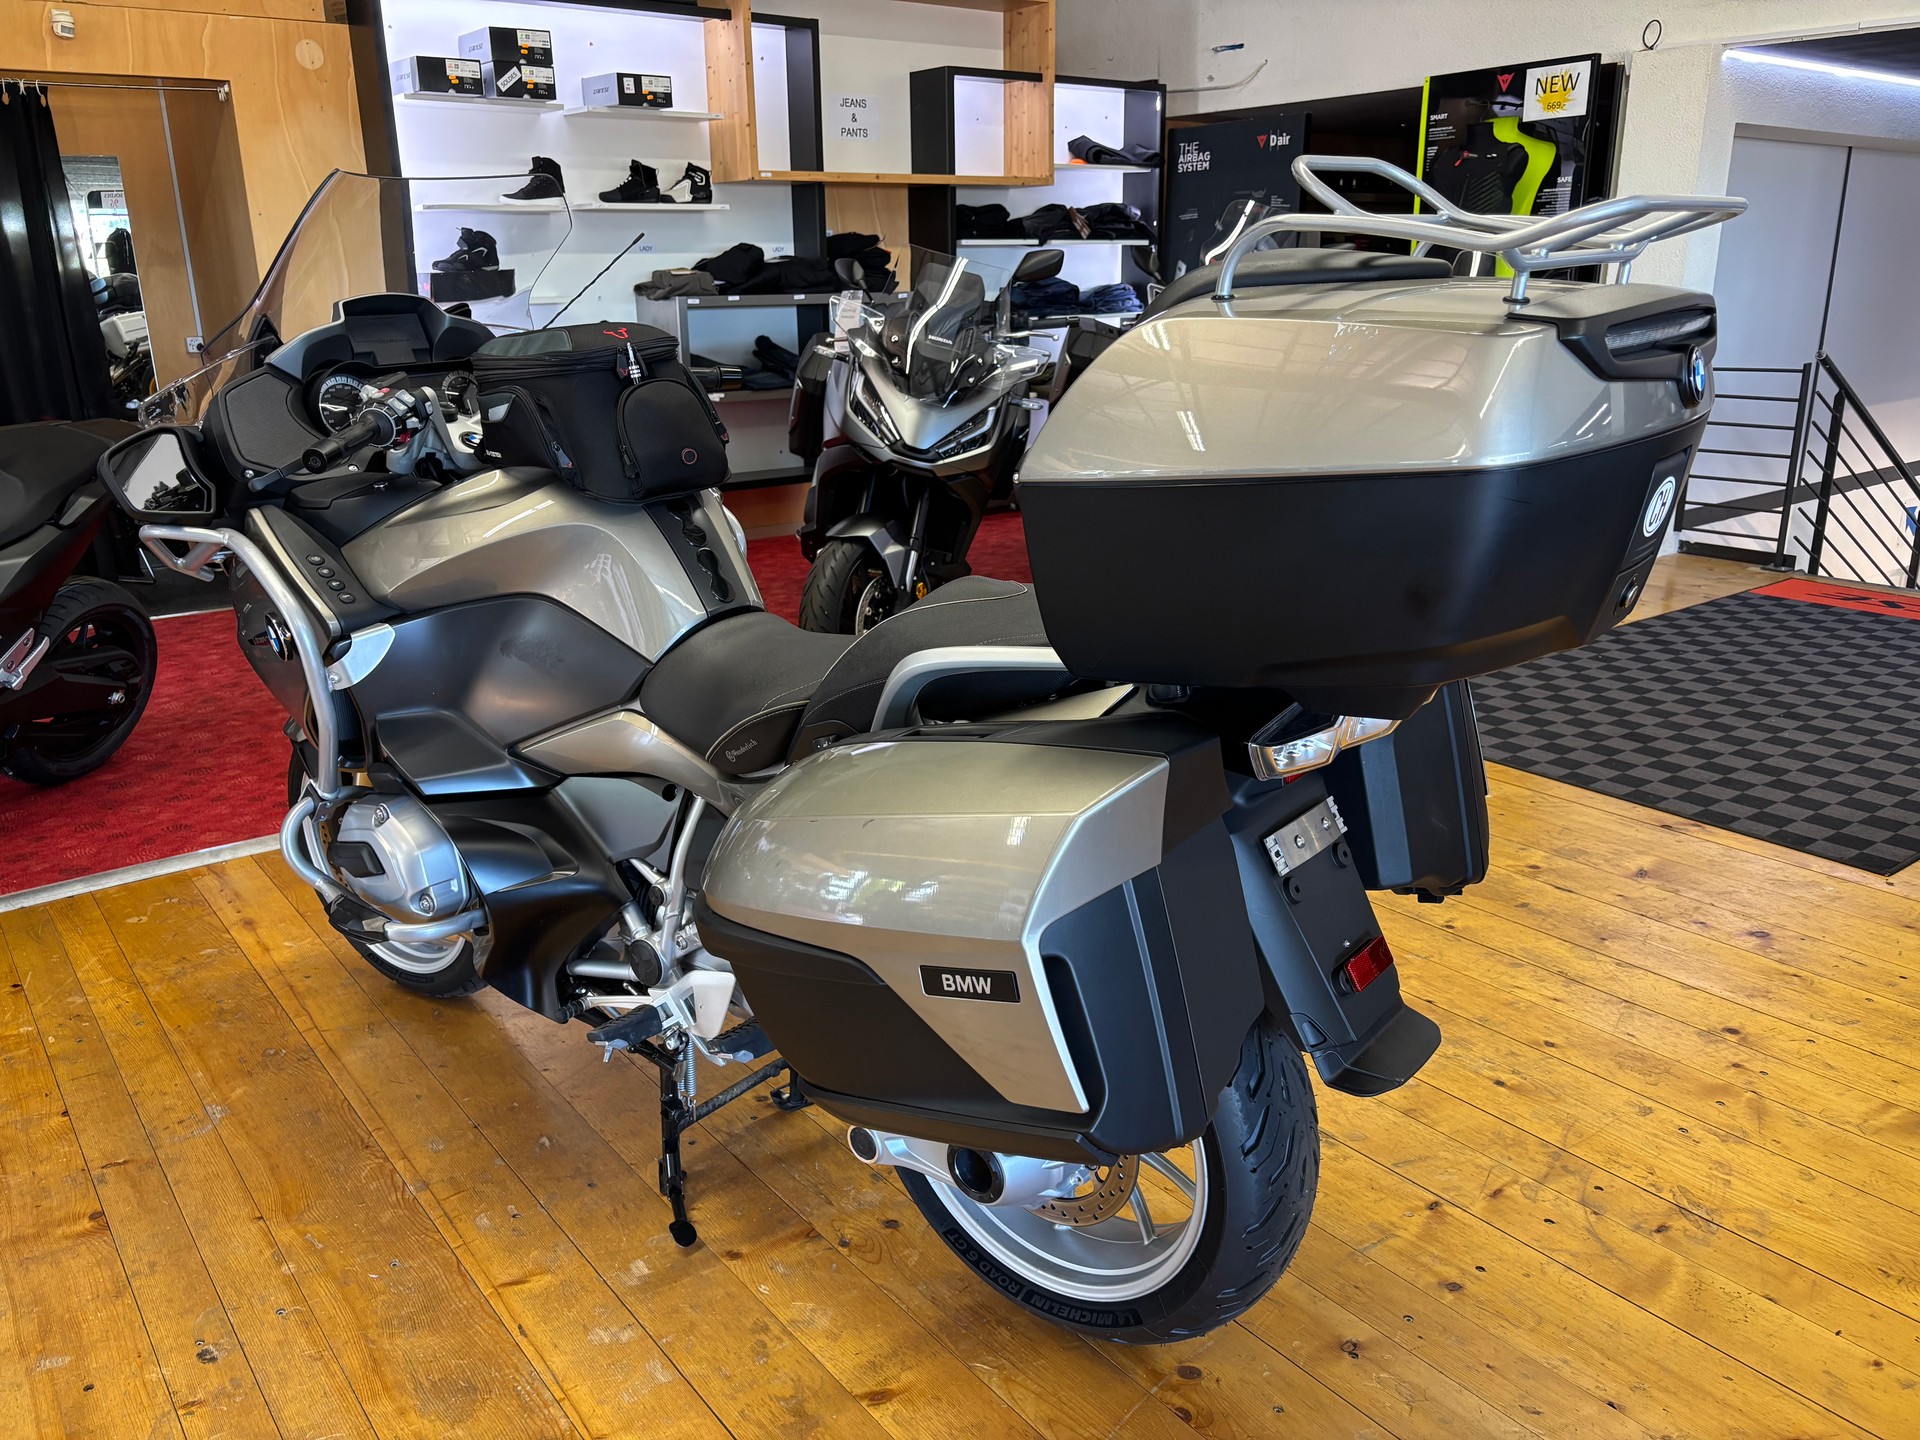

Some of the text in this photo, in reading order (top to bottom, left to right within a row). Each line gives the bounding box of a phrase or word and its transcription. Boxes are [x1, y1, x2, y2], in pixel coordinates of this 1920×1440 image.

[500, 71, 517, 89] SOLDES
[1535, 71, 1581, 95] NEW
[839, 97, 867, 109] JEANS
[850, 112, 858, 123] &
[1429, 113, 1449, 121] SMART
[840, 127, 869, 138] PANTS
[1178, 141, 1200, 154] THE
[1177, 151, 1211, 163] AIRBAG
[1177, 161, 1210, 173] SYSTEM
[1556, 175, 1573, 184] SAFE
[928, 334, 953, 345] HONDA
[1648, 486, 1672, 528] CH
[941, 973, 992, 995] BMW
[979, 1262, 1020, 1295] ROAD
[1030, 1294, 1114, 1326] MICHELIN
